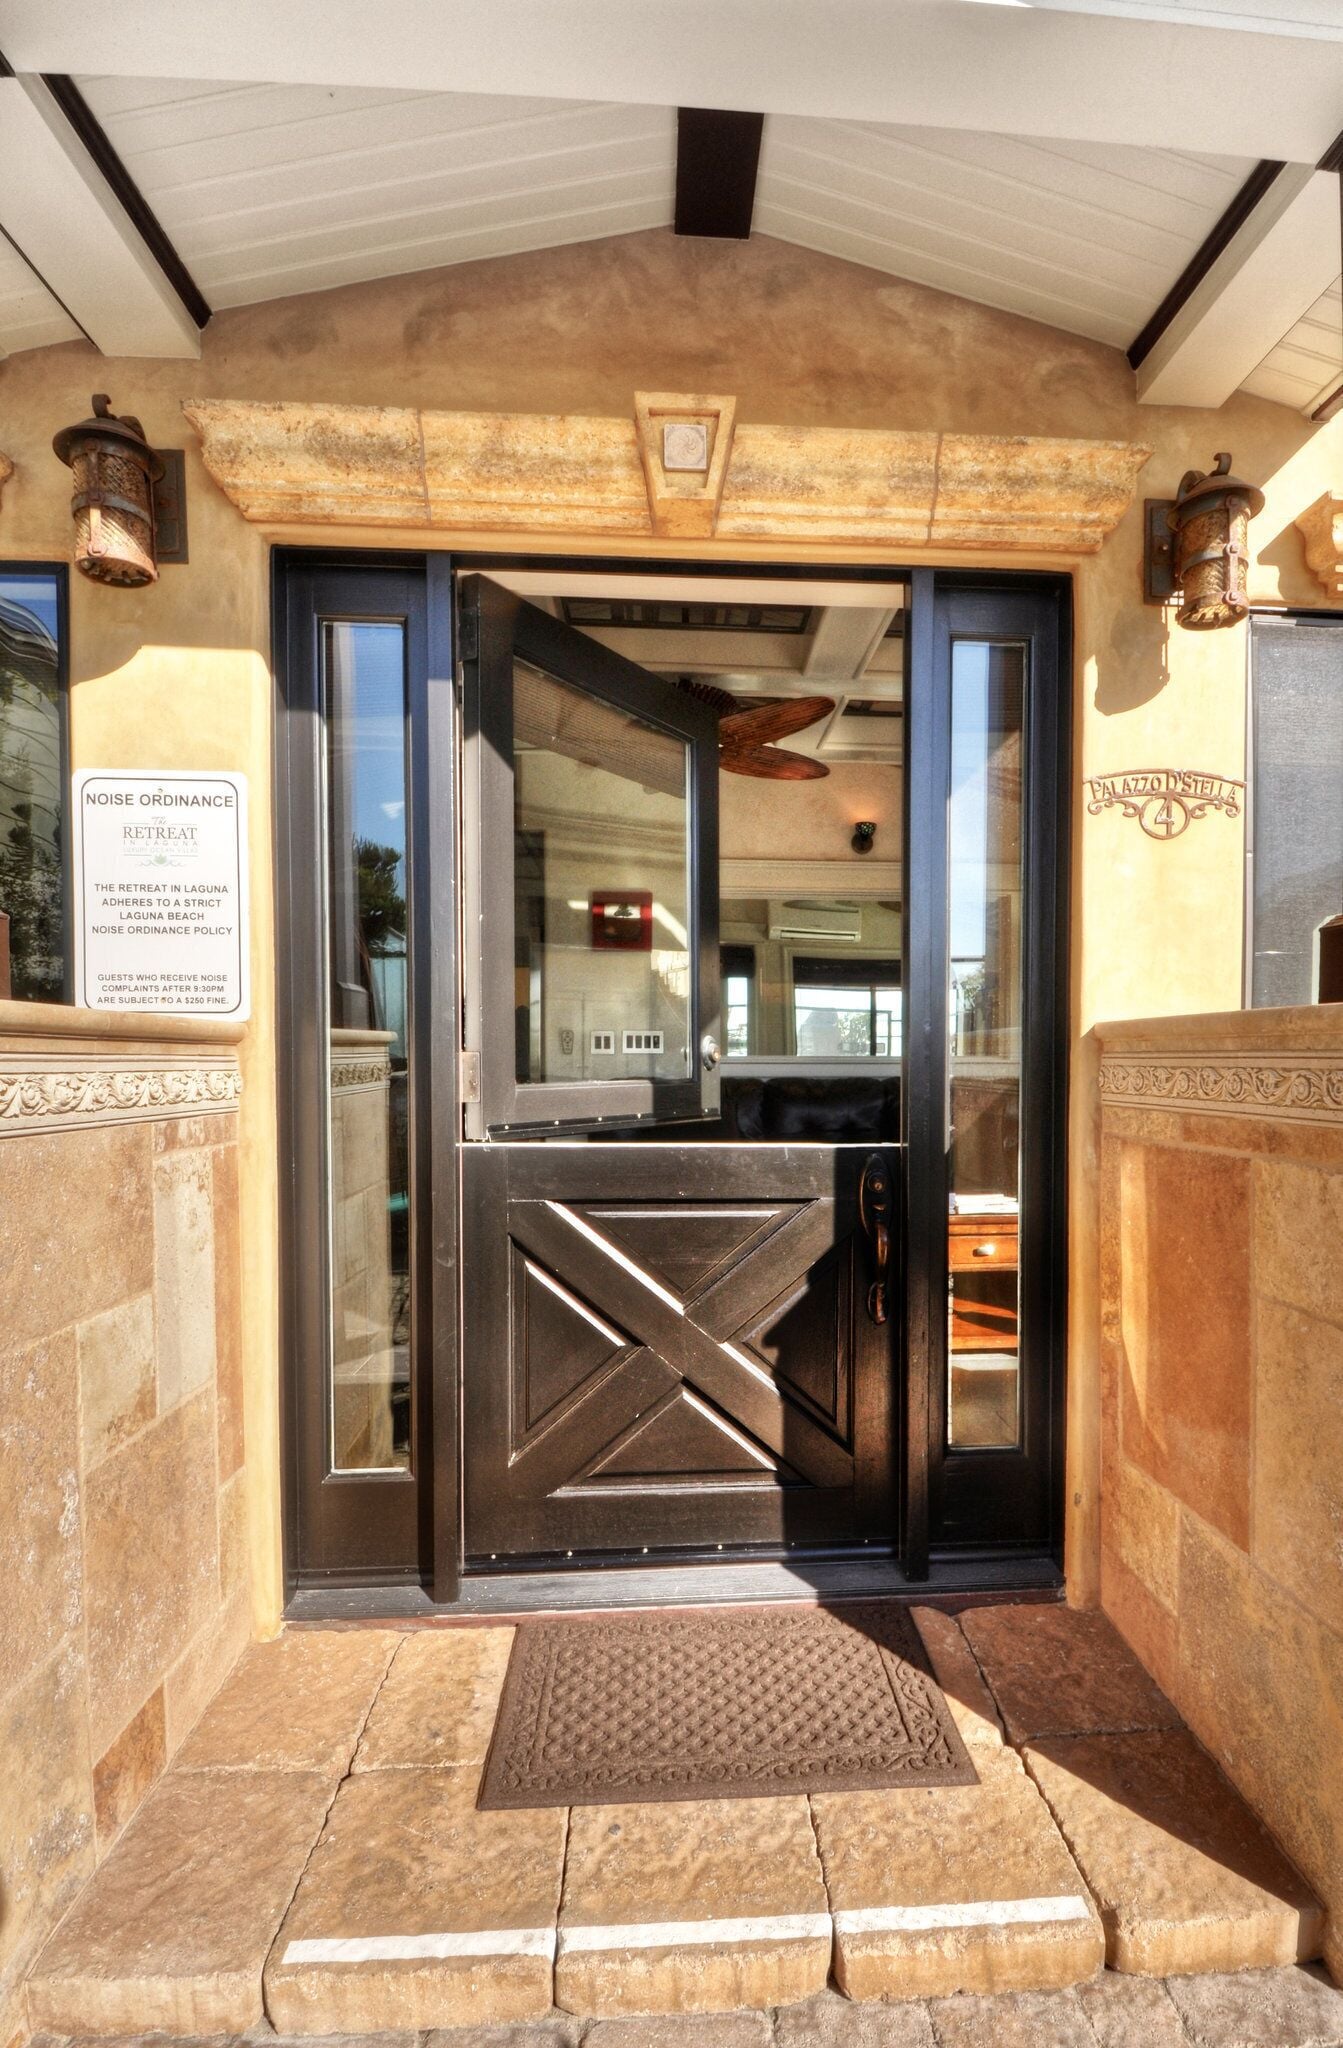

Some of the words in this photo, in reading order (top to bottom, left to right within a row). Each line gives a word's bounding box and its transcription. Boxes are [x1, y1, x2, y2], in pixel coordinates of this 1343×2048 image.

[1089, 776, 1161, 800] PALAZZO
[86, 793, 134, 805] NOISE
[139, 794, 233, 807] ORDINANCE
[151, 816, 167, 825] The
[1155, 796, 1175, 836] 4
[123, 826, 197, 839] RETREAT
[95, 884, 115, 892] THE
[118, 884, 167, 892] RETREAT
[184, 885, 228, 893] LAGUNA
[102, 898, 153, 906] ADHERES
[184, 899, 221, 907] STRICT
[120, 912, 164, 920] LAGUNA
[167, 912, 204, 920] BEACH
[92, 926, 124, 934] NOISE
[127, 926, 190, 934] ORDINANCE
[194, 927, 232, 935] POLICY
[185, 996, 204, 1004] $250
